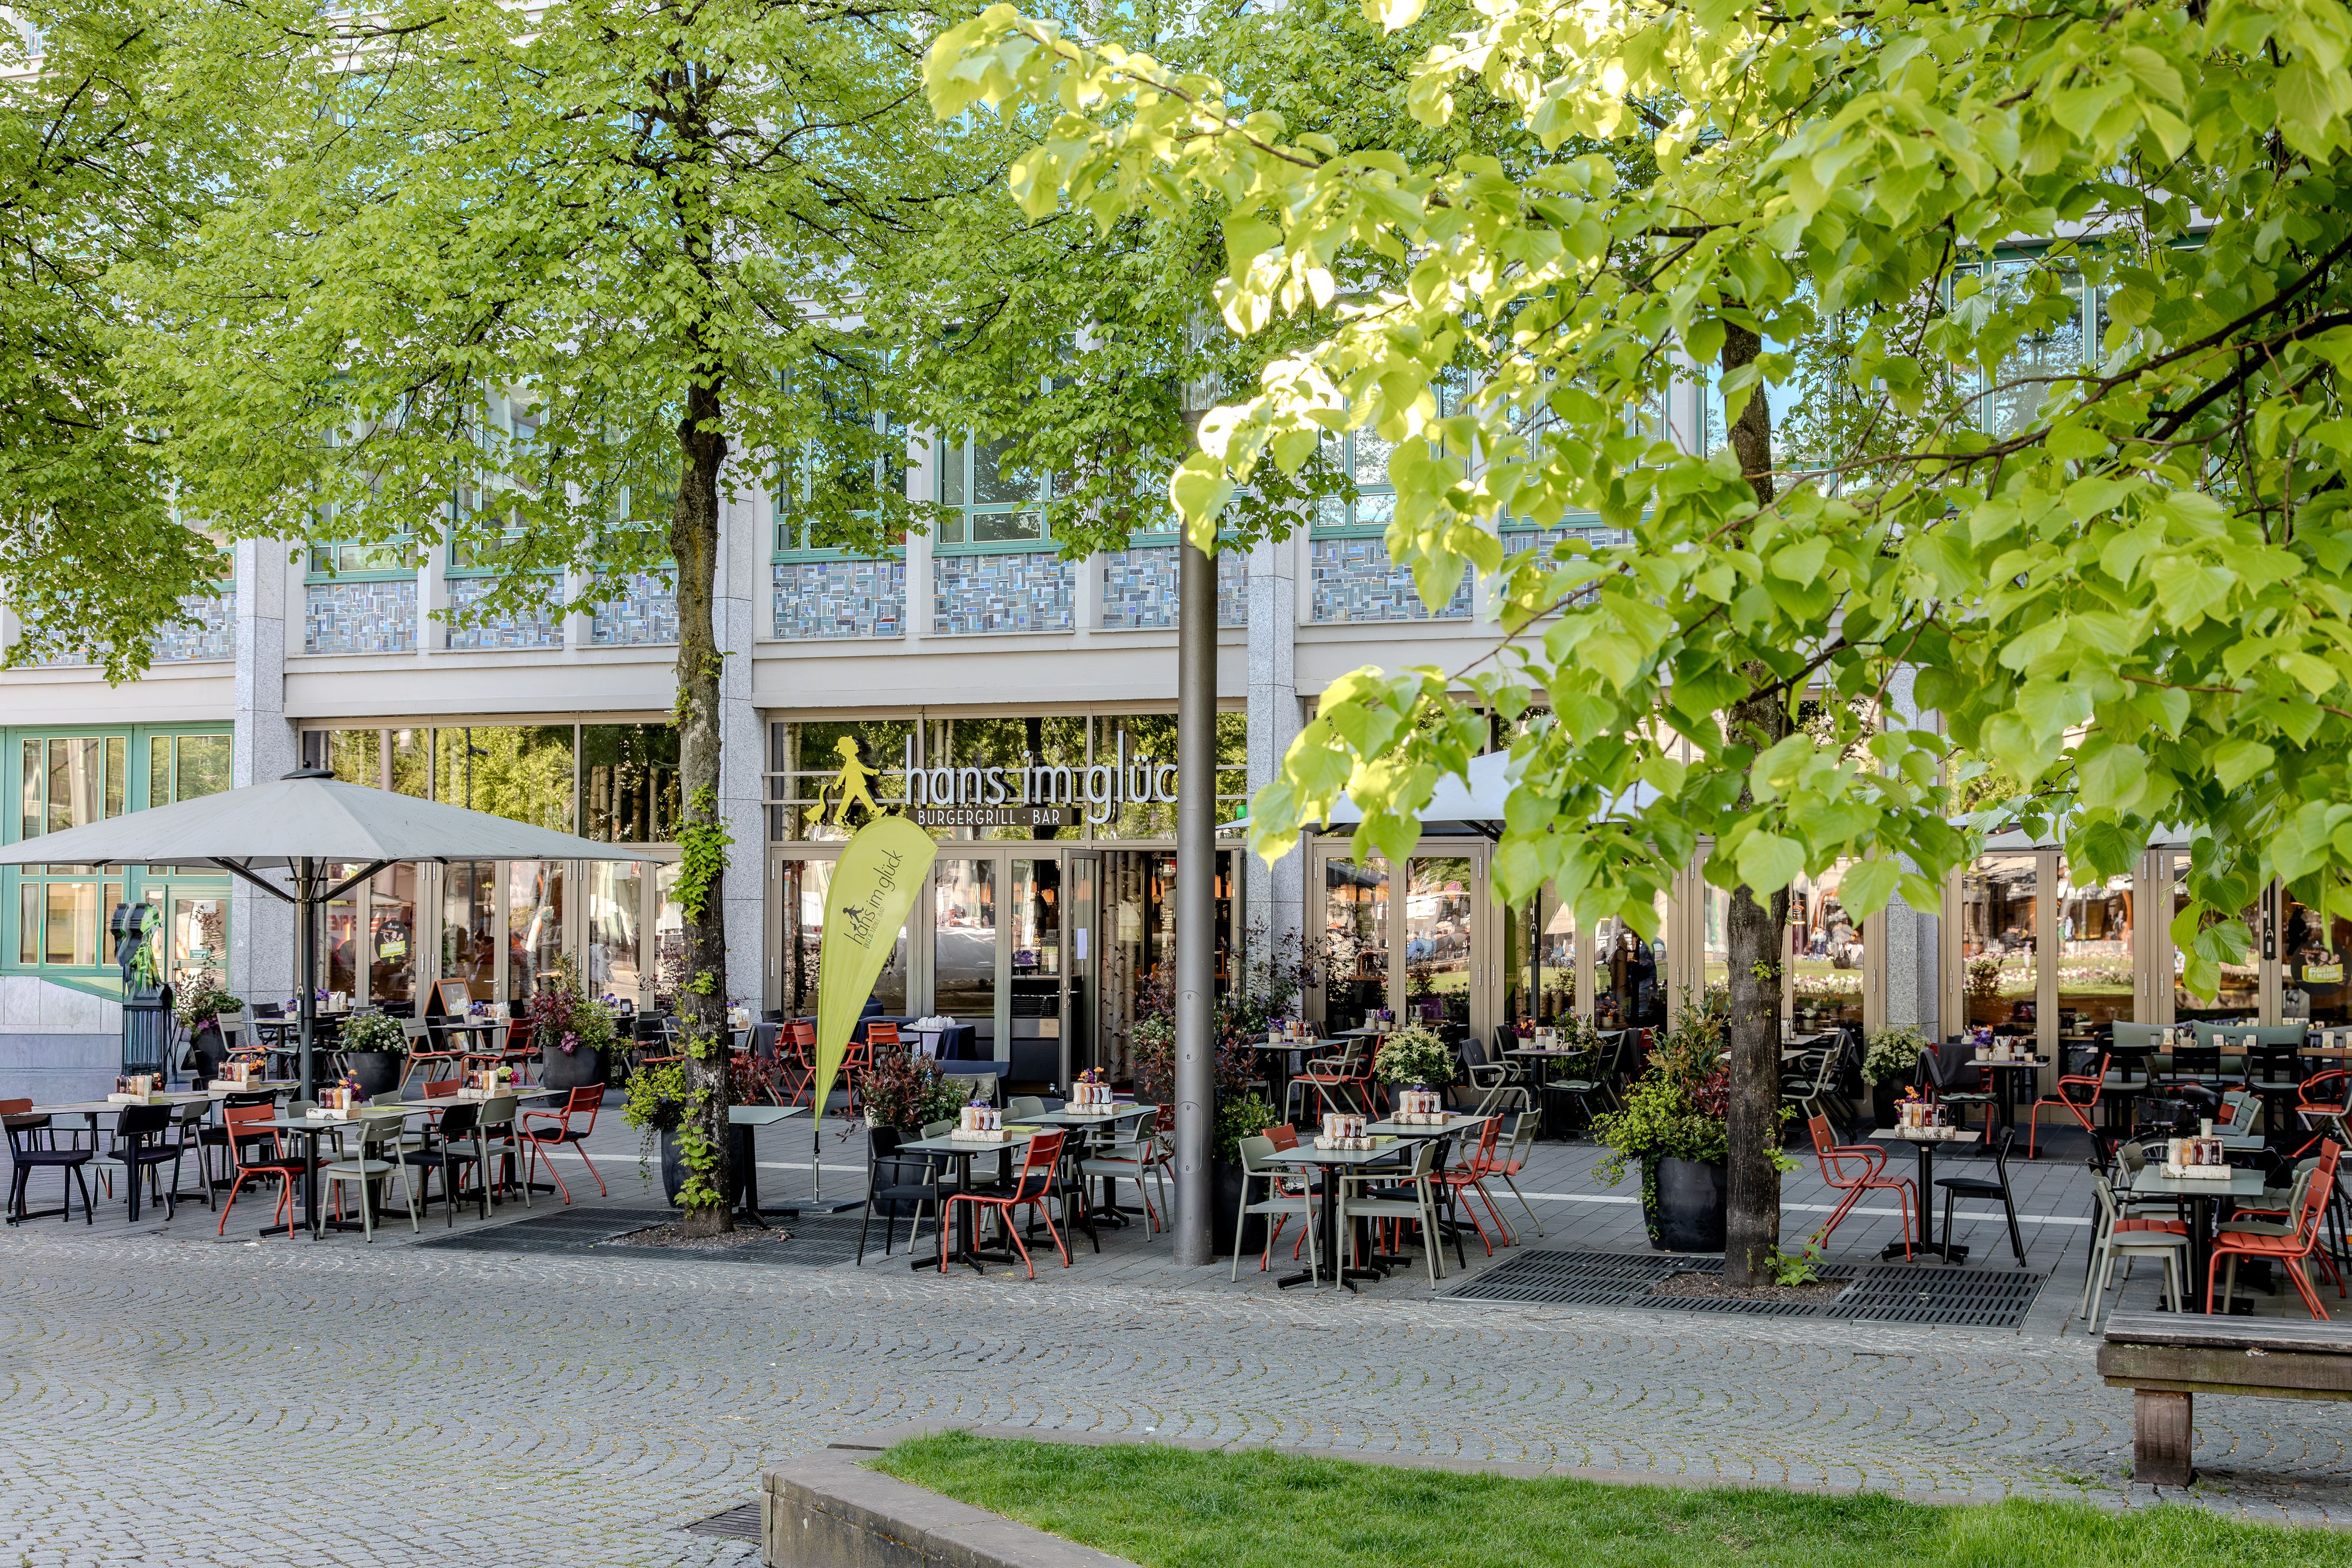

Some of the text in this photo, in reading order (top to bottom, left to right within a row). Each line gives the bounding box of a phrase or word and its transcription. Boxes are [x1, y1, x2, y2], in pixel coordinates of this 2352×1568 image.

[906, 730, 1178, 824] hans im glüc
[918, 809, 1060, 825] BURGERGRILL BAR
[873, 849, 904, 892] glück
[866, 889, 886, 909] im
[843, 909, 876, 945] hans
